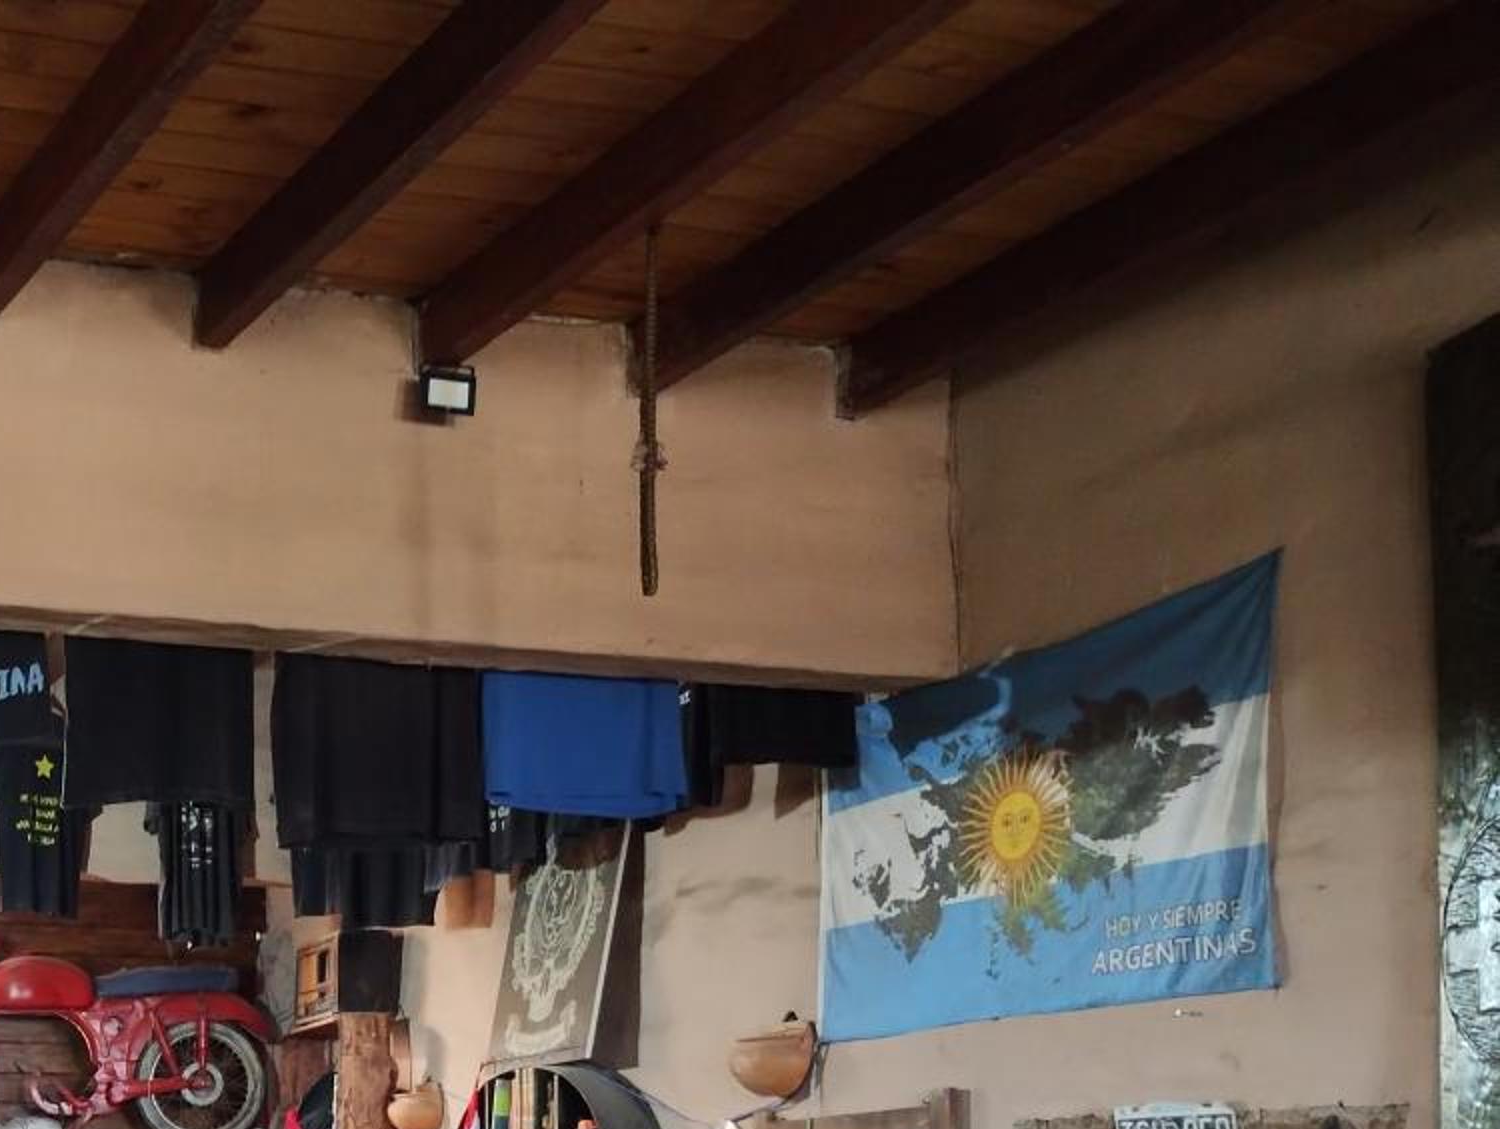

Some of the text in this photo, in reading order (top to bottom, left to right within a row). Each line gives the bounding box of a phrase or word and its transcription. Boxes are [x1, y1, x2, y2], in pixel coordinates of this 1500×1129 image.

[1105, 899, 1243, 939] HOY Y SIEMPRE
[1091, 927, 1257, 975] ARGENTINAS
